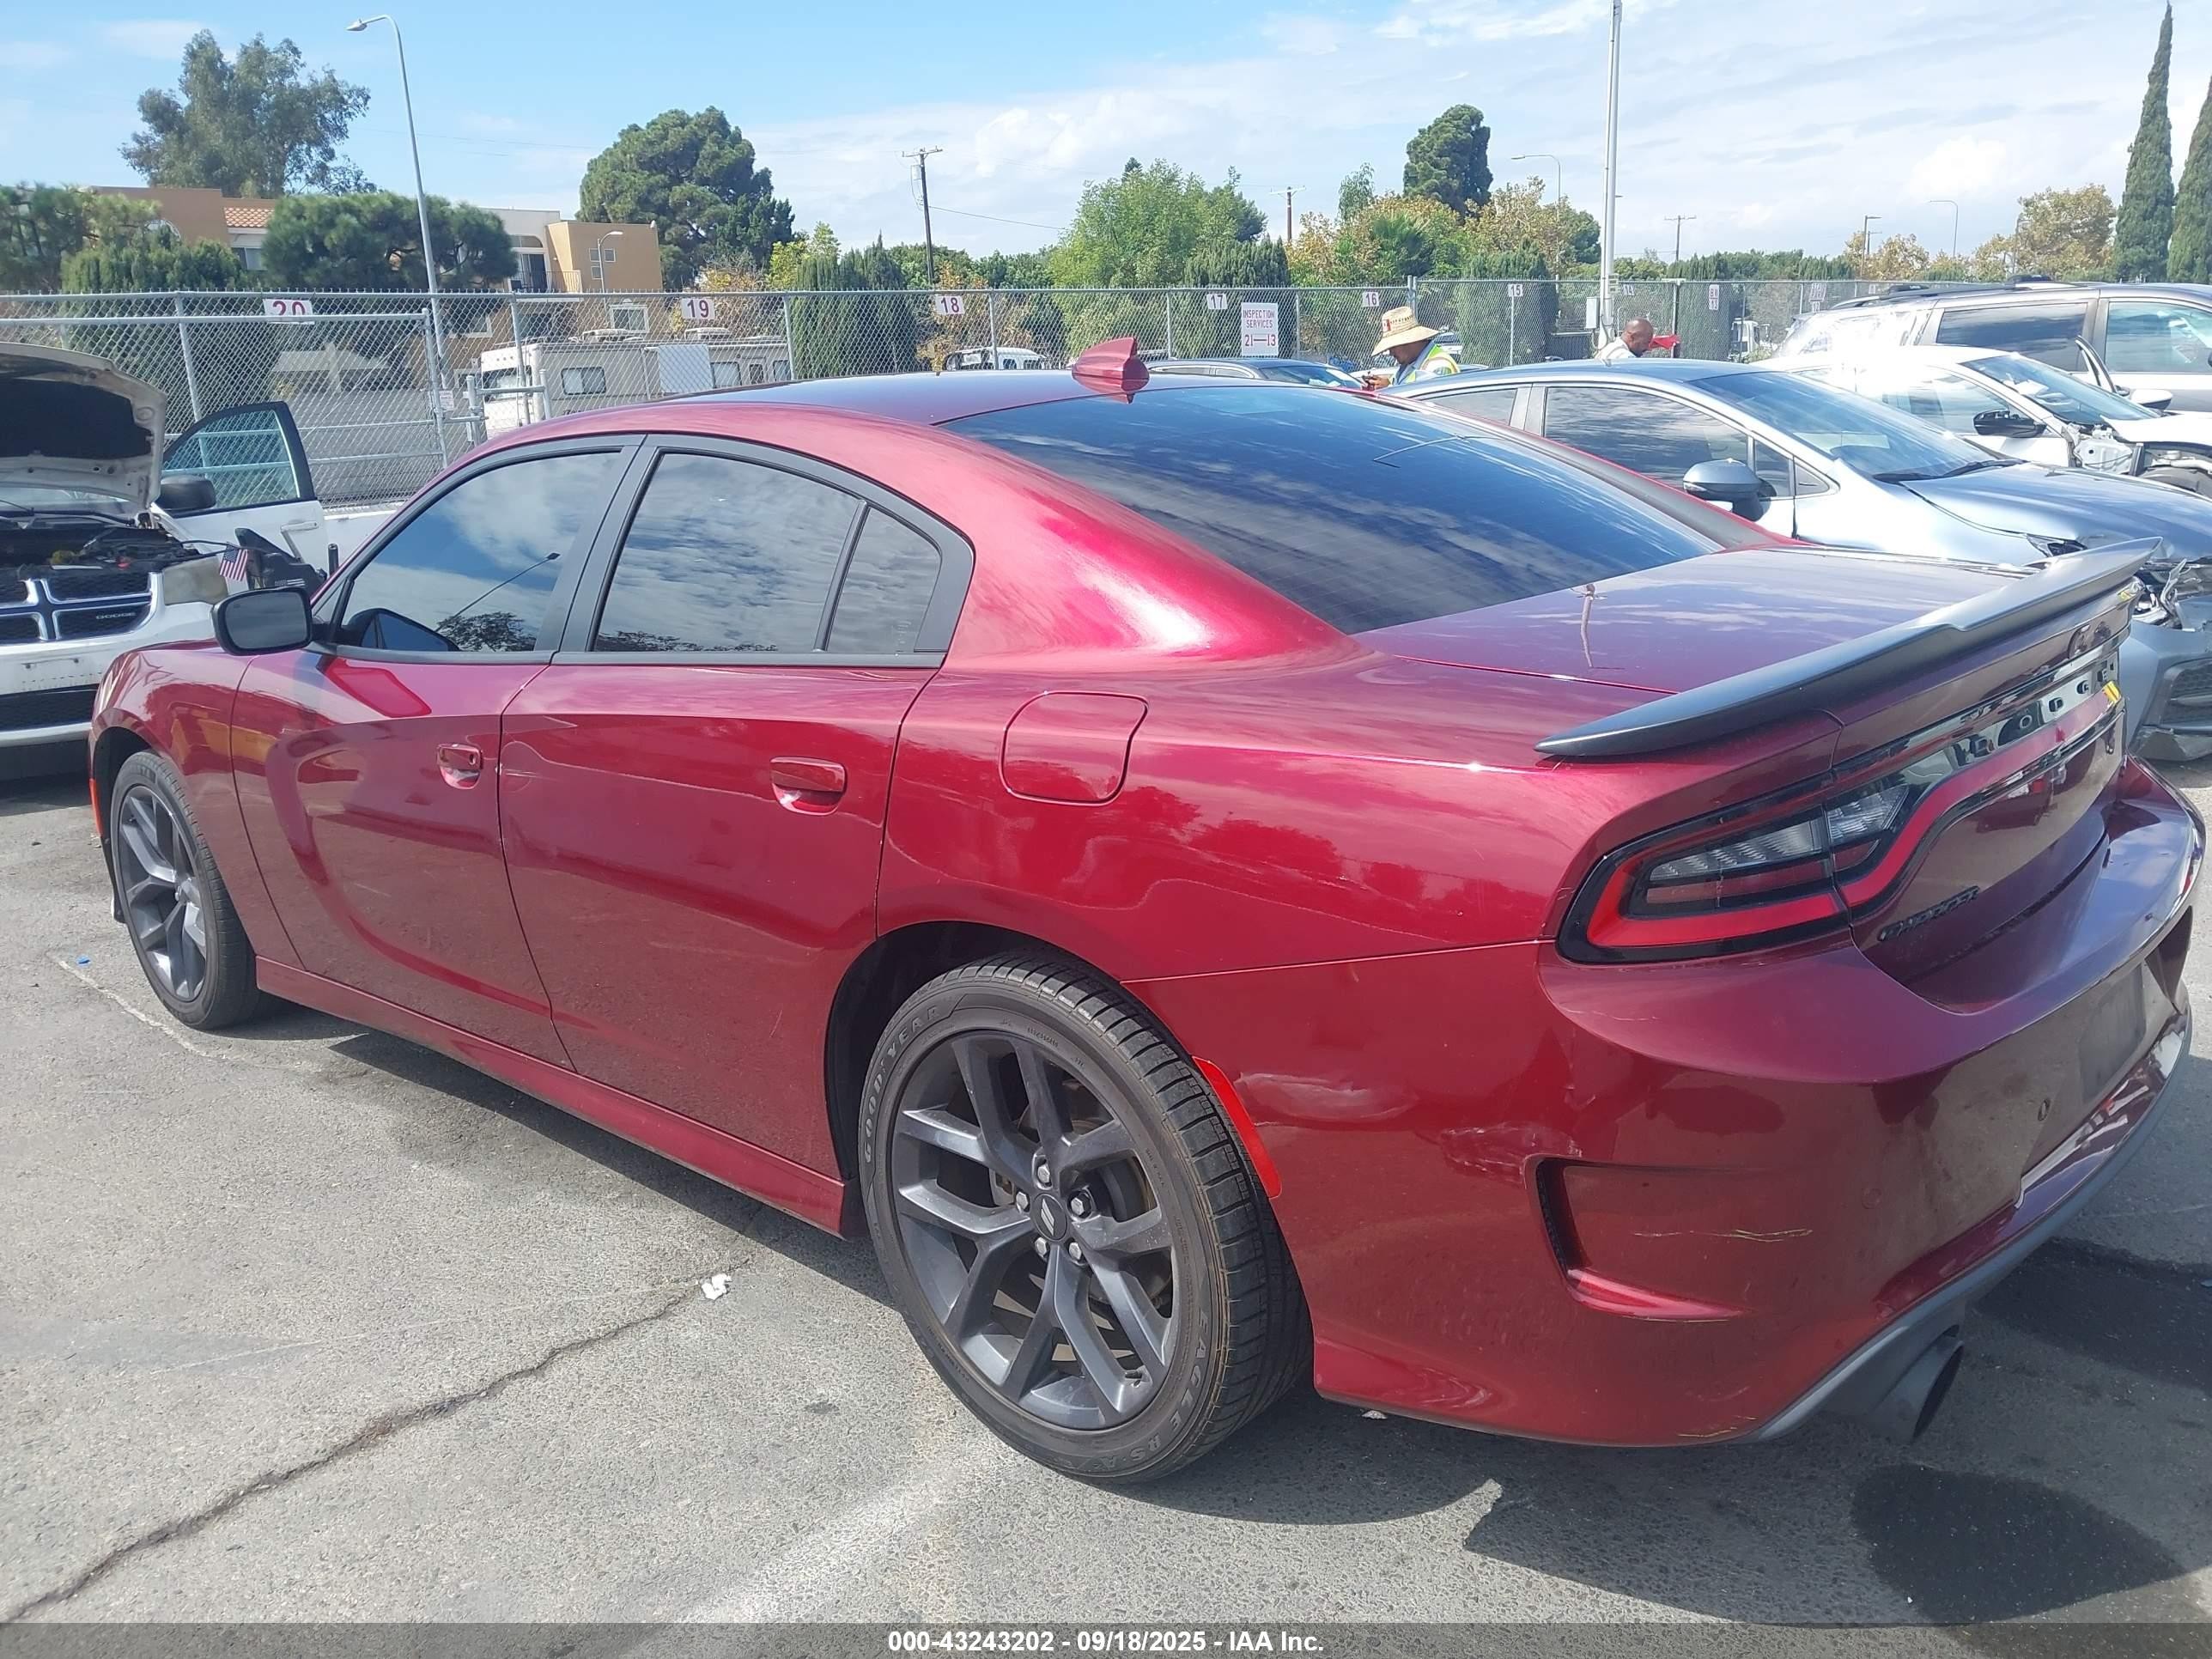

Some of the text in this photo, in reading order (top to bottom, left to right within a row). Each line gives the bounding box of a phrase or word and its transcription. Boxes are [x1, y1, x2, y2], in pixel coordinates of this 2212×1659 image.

[1511, 284, 1521, 296] 15
[941, 297, 960, 313] 18
[1211, 295, 1224, 309] 17
[1366, 293, 1377, 306] 16
[272, 300, 306, 316] 20
[687, 299, 709, 318] 19
[1243, 309, 1275, 319] INSPECTION
[1246, 319, 1273, 329] SERVICES
[1971, 669, 2109, 760] DODGE
[864, 1005, 939, 1164] GOODYEAR
[1170, 1306, 1208, 1432] EAGLE
